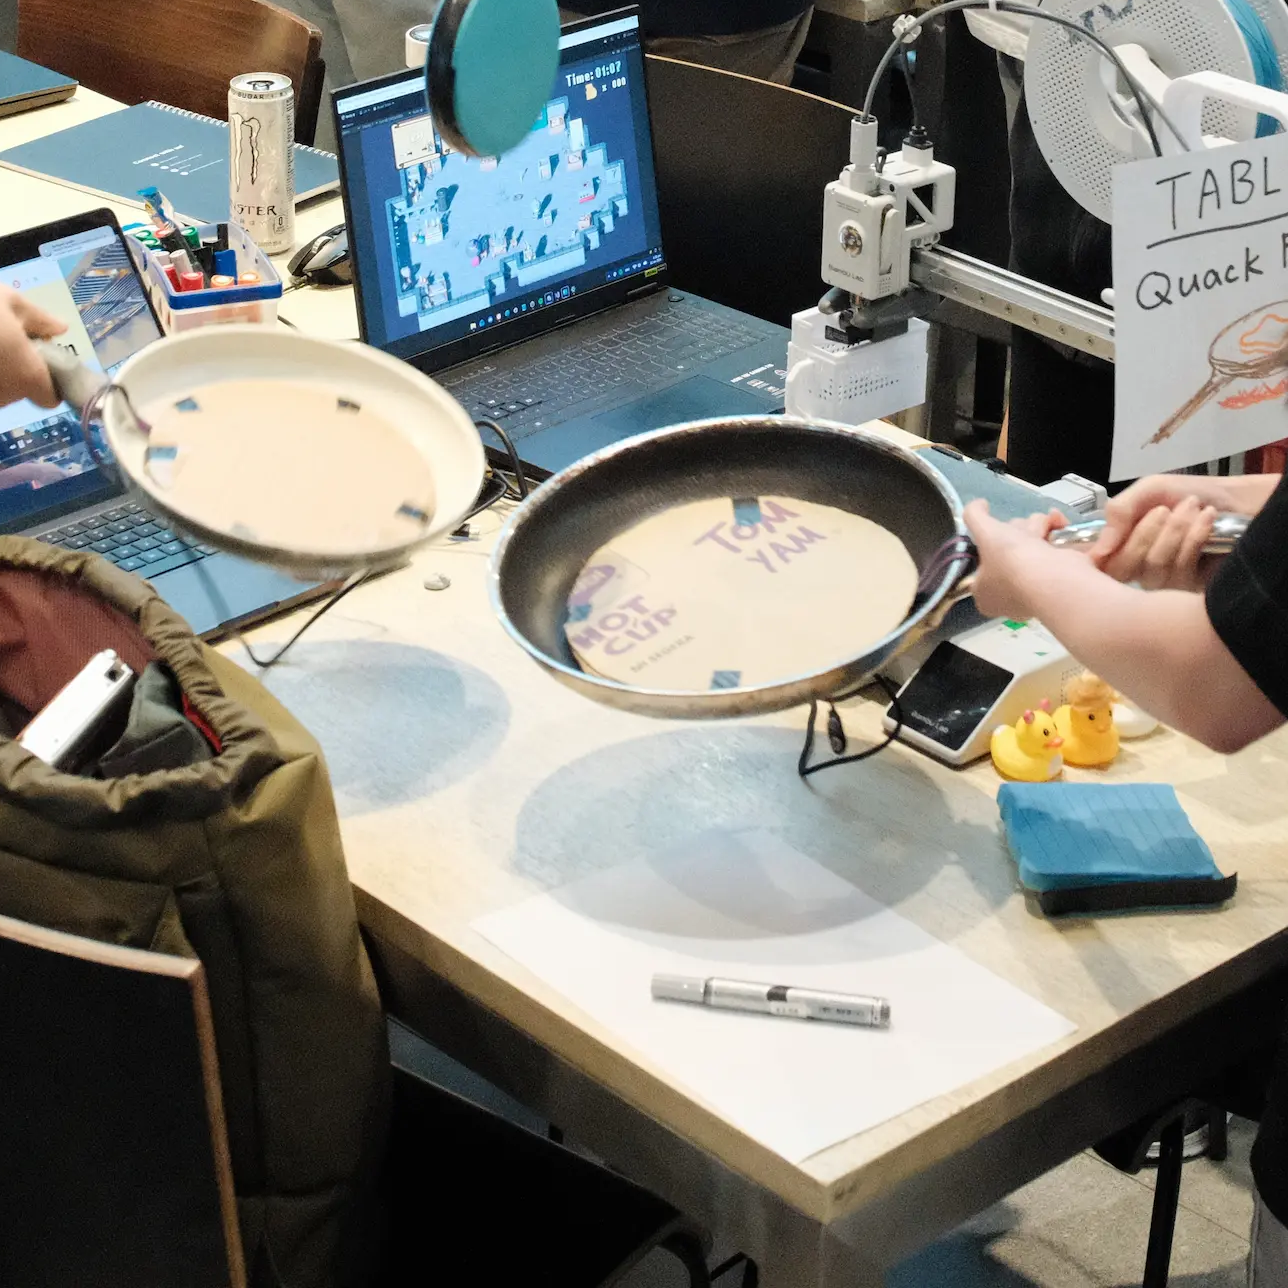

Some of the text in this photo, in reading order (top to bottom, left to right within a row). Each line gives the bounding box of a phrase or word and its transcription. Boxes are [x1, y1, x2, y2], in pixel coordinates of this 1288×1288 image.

[565, 60, 622, 88] Time: 01:07
[1135, 247, 1264, 311] Quack
[693, 500, 801, 554] TOM
[745, 525, 828, 574] YAM
[571, 595, 650, 651] HOT
[603, 605, 678, 656] CUP
